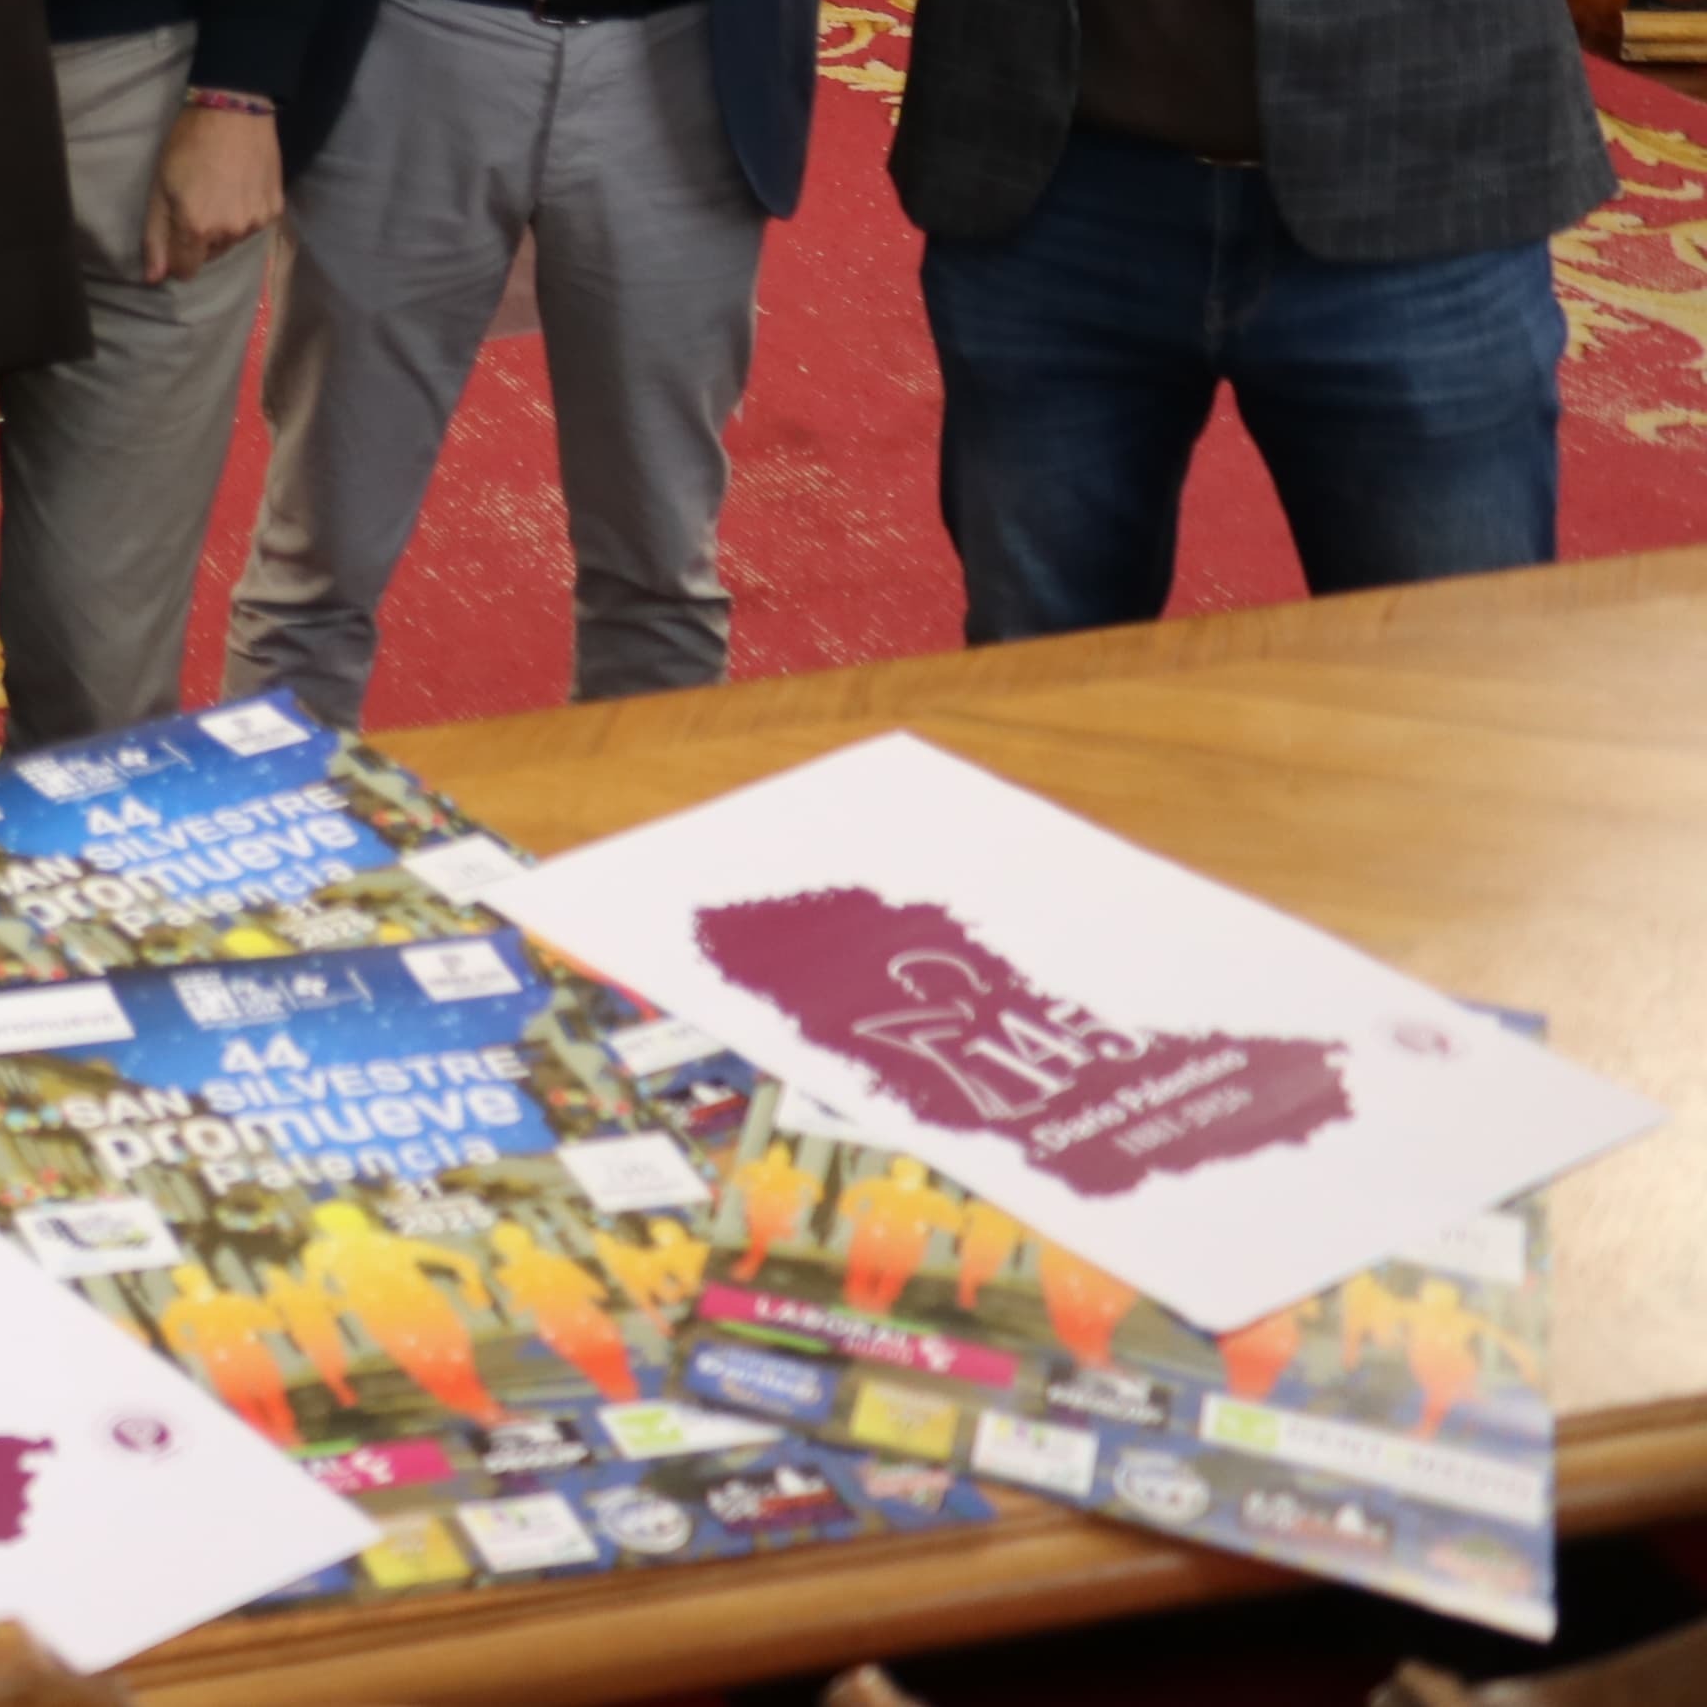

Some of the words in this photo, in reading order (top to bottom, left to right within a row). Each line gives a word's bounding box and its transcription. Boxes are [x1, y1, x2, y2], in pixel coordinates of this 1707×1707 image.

[83, 785, 349, 871] SILVESTRE
[89, 797, 161, 836] 44
[112, 859, 355, 938] Palencia
[219, 1032, 311, 1076] 44
[963, 1002, 1149, 1094] 145
[61, 1089, 193, 1133] SAN
[201, 1048, 532, 1115] SILVESTRE
[94, 1083, 524, 1182] promueve
[204, 1133, 499, 1197] Palencia
